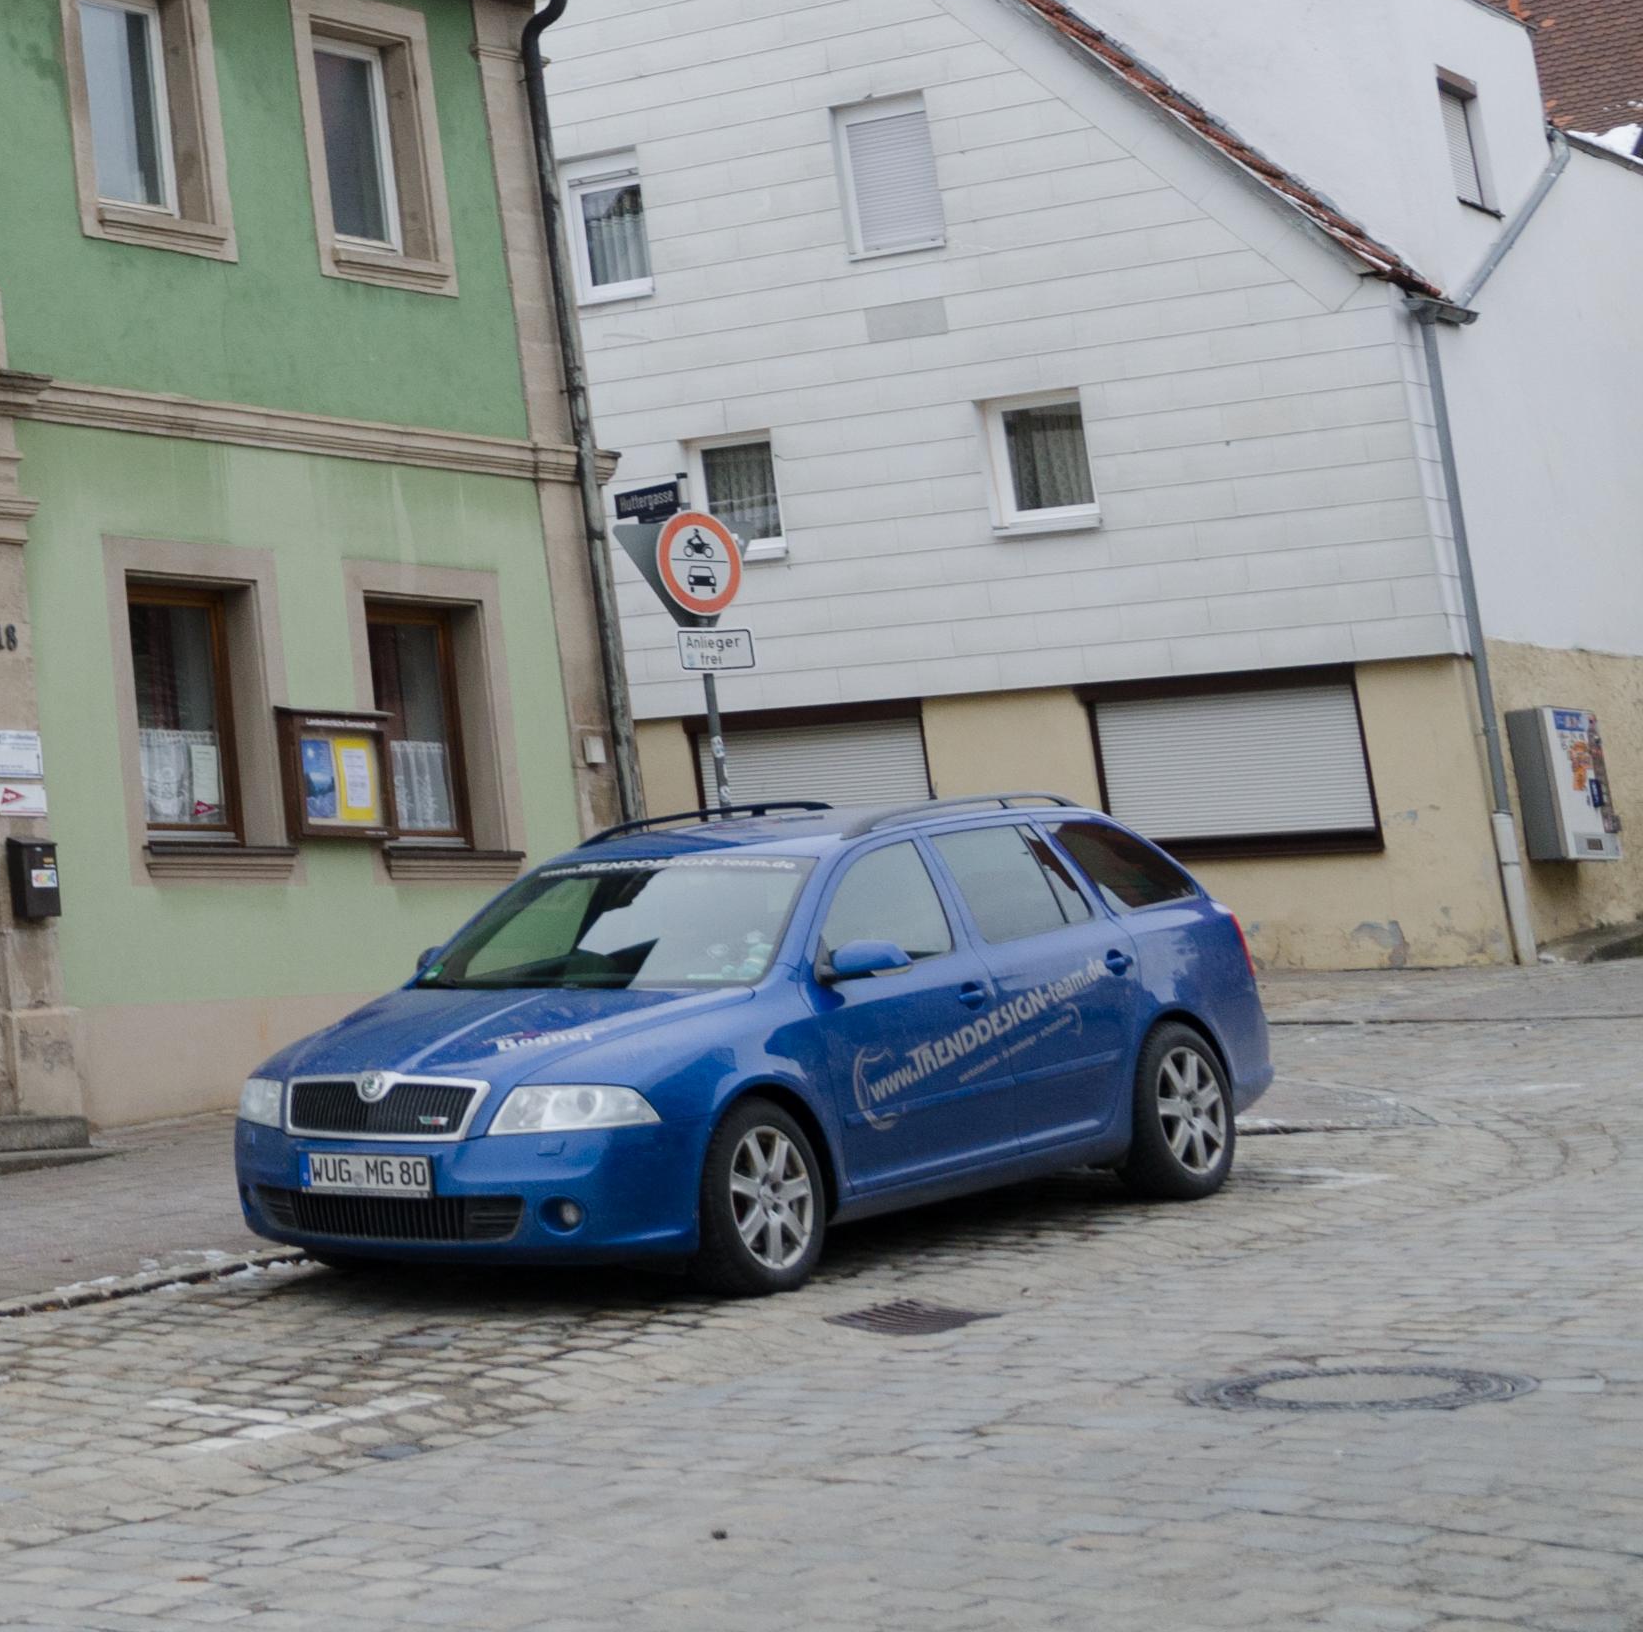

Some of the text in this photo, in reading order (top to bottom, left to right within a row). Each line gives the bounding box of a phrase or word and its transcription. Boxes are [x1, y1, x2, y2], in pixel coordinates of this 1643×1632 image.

[686, 635, 741, 652] Anlieger
[700, 652, 723, 665] frei
[310, 1157, 352, 1183] WUG
[365, 1159, 394, 1185] MG
[399, 1160, 427, 1186] 80
